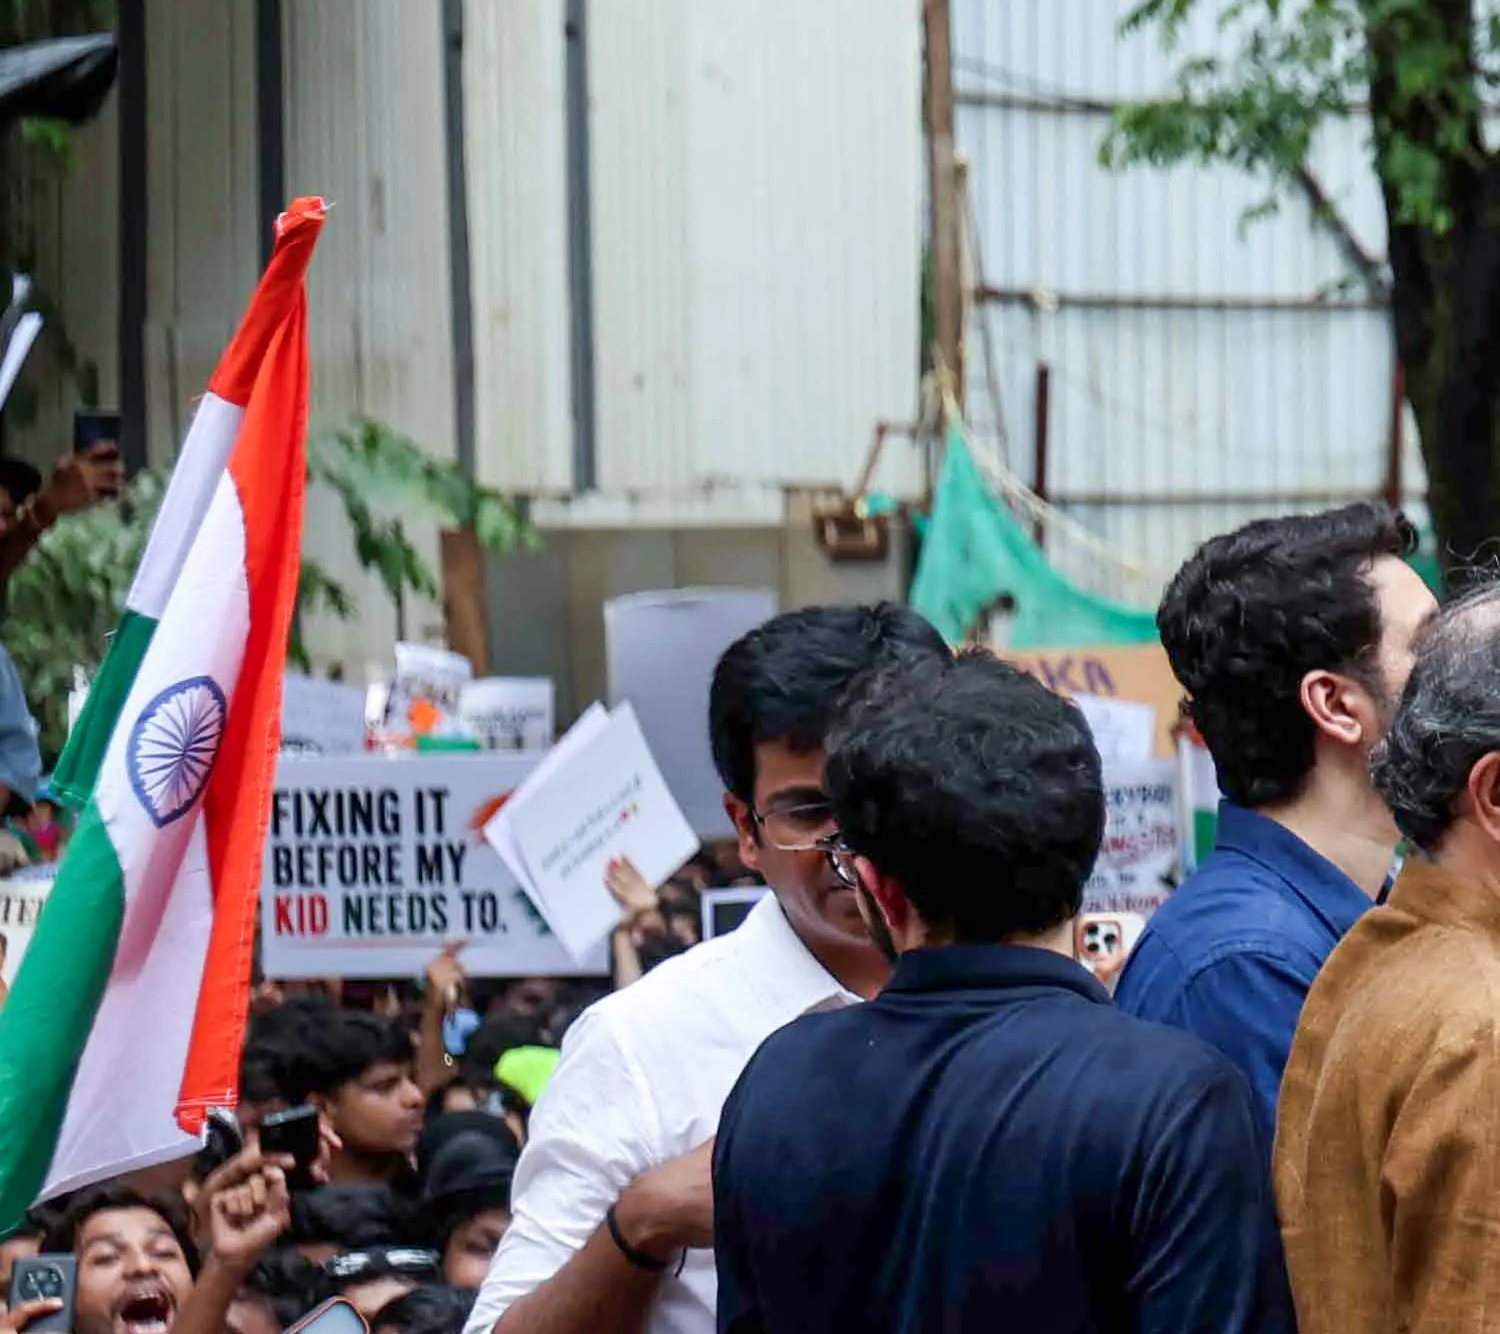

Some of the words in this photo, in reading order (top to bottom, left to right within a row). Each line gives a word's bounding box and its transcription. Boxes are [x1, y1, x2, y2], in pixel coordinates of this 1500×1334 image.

[272, 788, 399, 837] FIXING
[413, 787, 450, 836] IT
[272, 843, 407, 889] BEFORE
[416, 844, 466, 889] MY
[274, 895, 330, 936] KID
[342, 892, 448, 933] NEEDS
[458, 891, 508, 933] TO.
